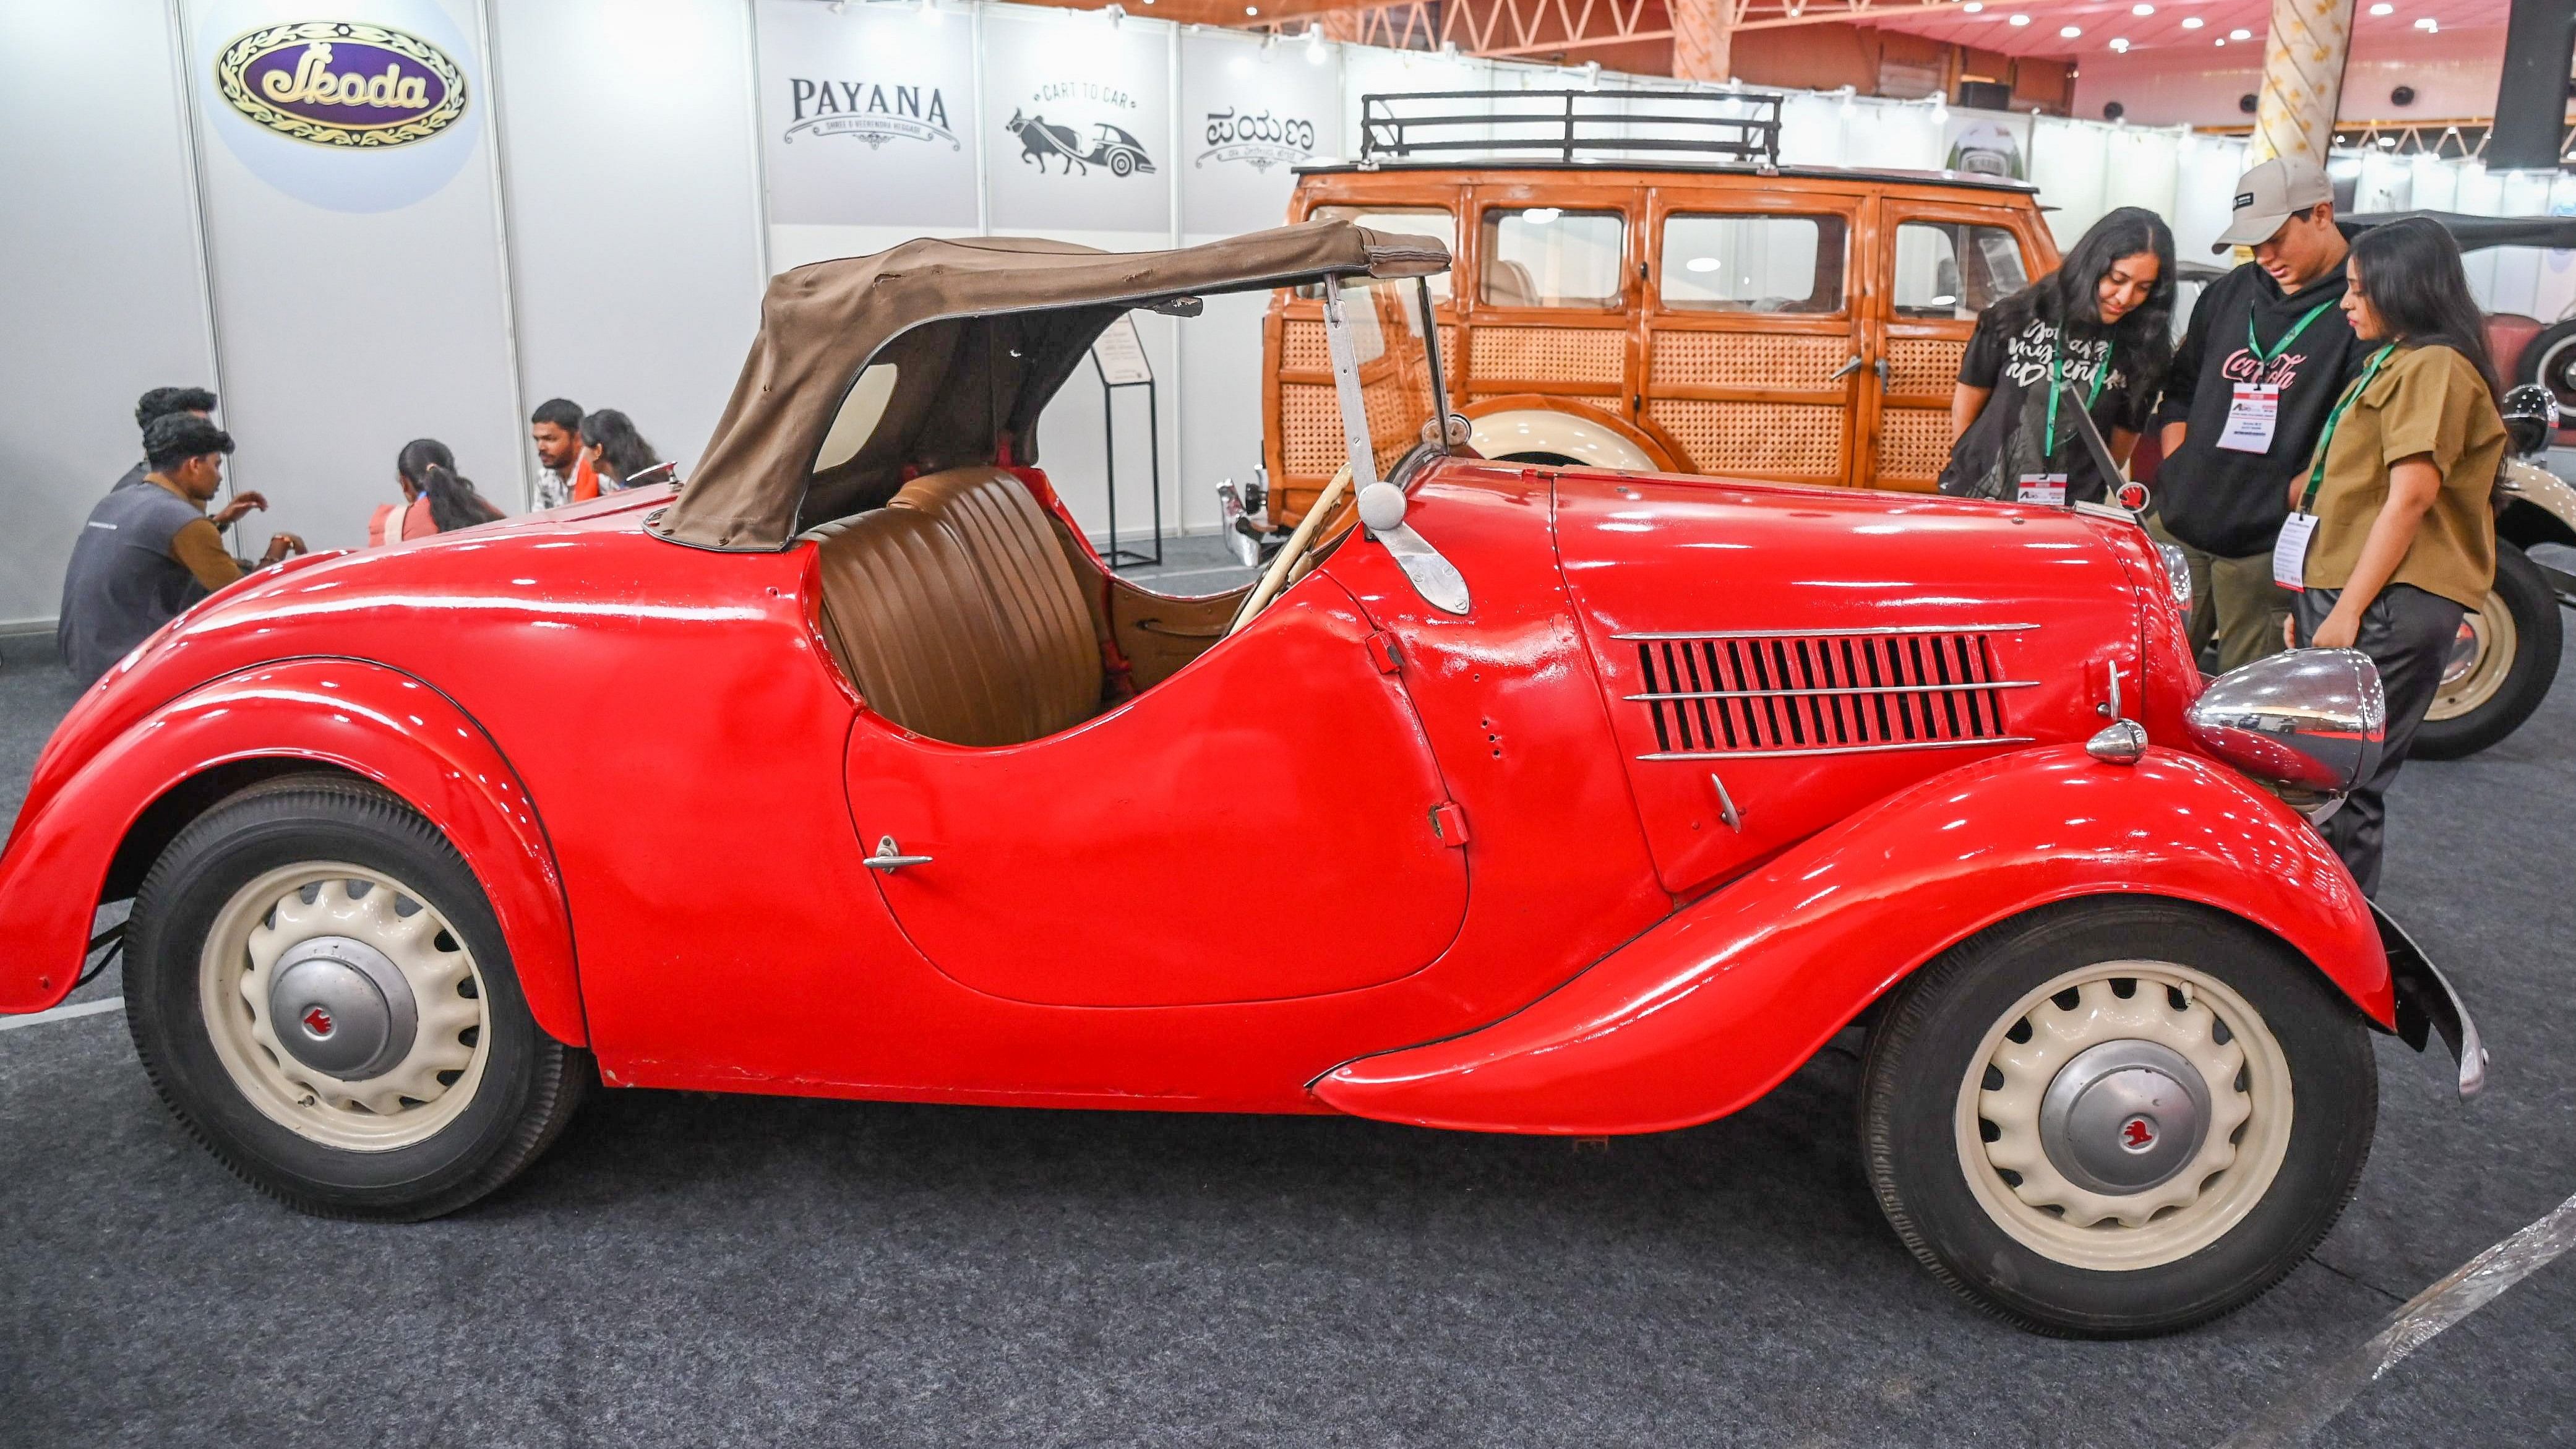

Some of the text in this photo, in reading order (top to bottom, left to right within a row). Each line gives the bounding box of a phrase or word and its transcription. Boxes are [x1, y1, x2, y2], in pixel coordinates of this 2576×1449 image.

[791, 79, 950, 129] PAYANA
[1042, 82, 1128, 109] CART TO CAR
[1207, 106, 1315, 150] ಪಯಣ
